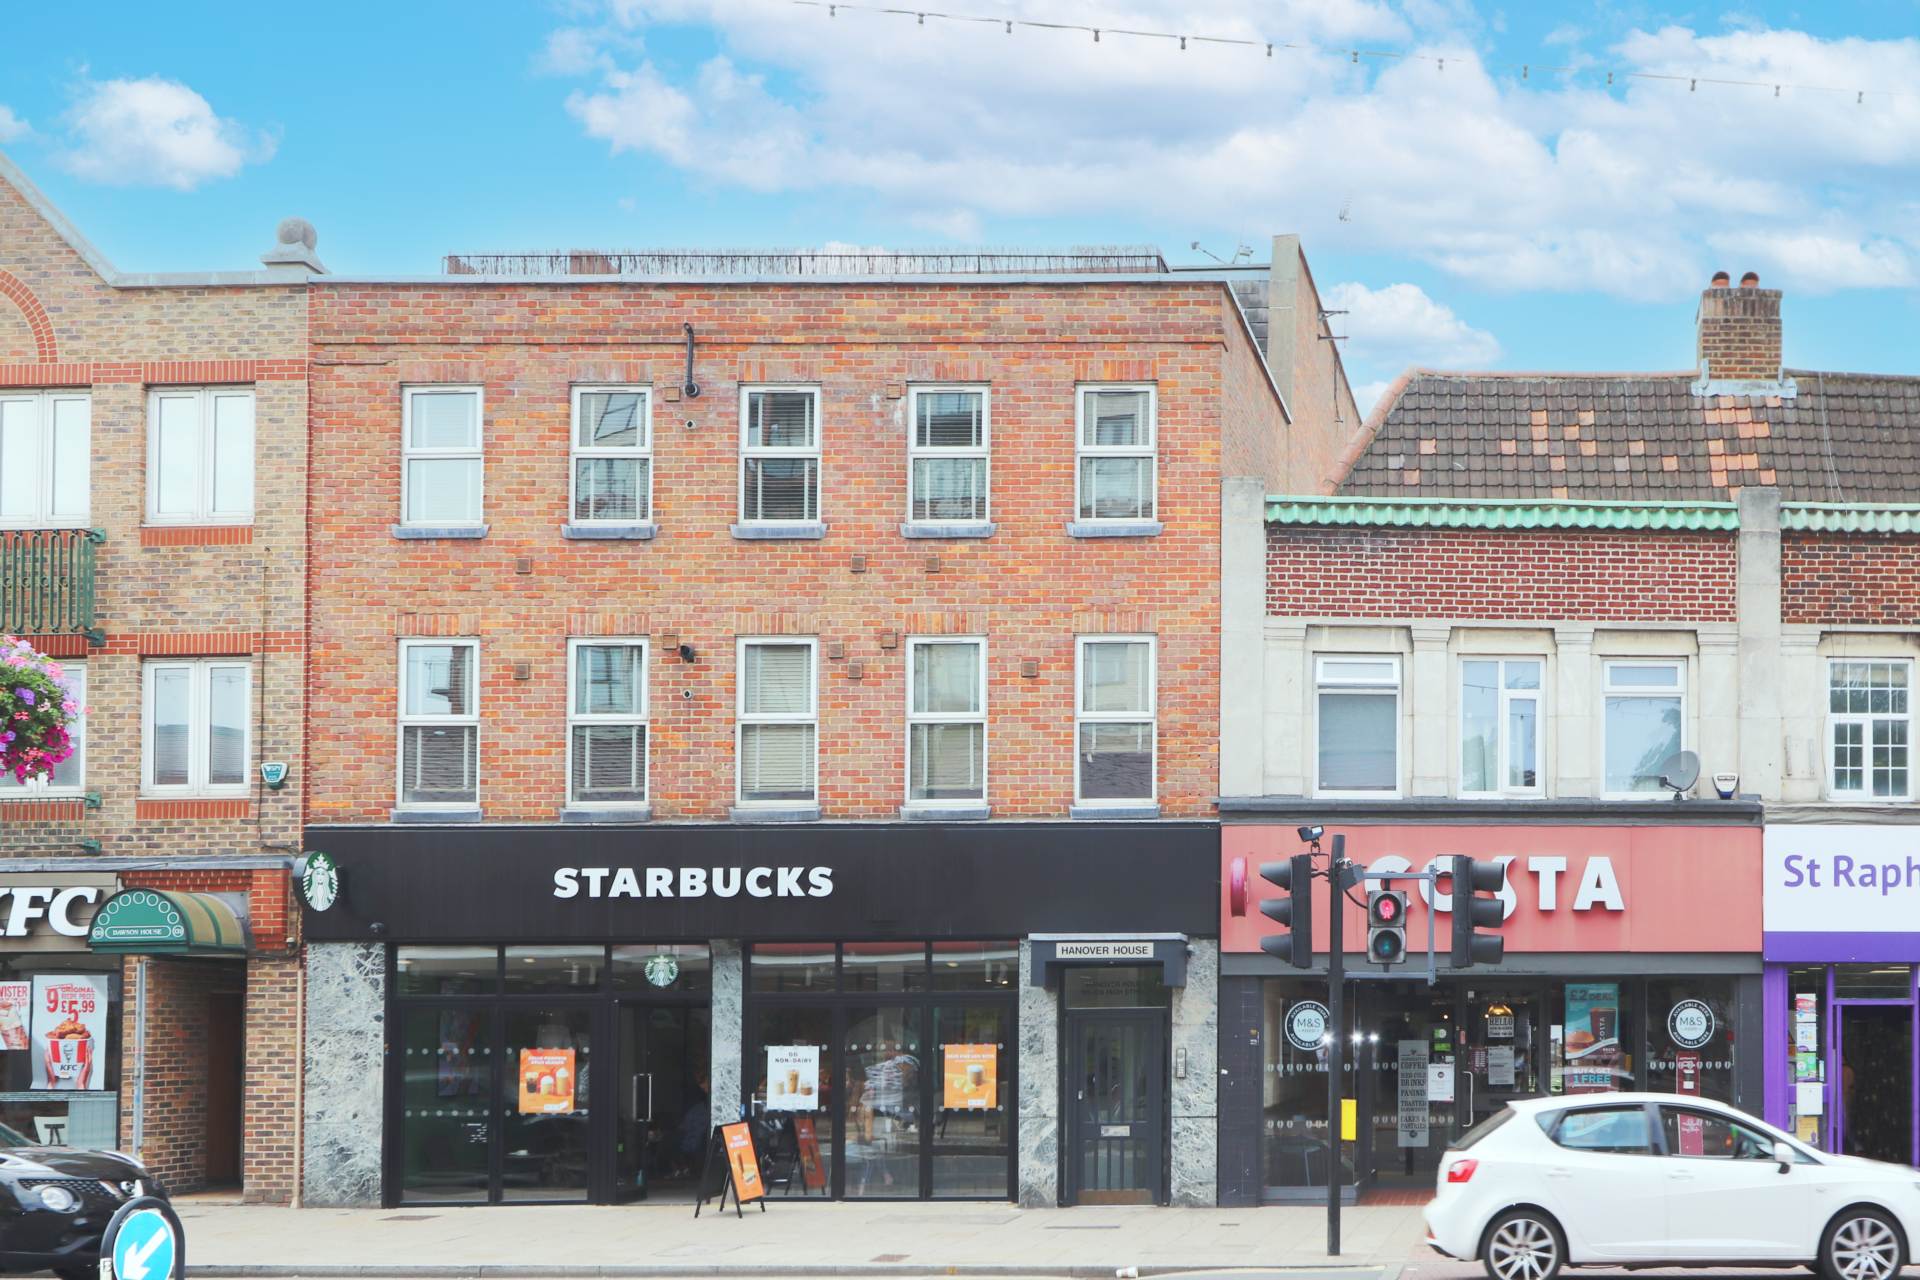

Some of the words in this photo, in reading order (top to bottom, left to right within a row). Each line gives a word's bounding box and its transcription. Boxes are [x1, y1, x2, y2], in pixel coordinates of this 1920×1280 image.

[552, 865, 834, 899] STARBUCKS
[1783, 854, 1821, 888] St
[1833, 855, 1920, 896] Raph
[0, 886, 98, 937] FC
[1061, 946, 1109, 955] HANOVER
[1113, 946, 1149, 955] HOUSE
[46, 988, 59, 1013] 9
[1297, 1018, 1321, 1028] M&S
[1680, 1016, 1703, 1026] M&S
[1581, 1074, 1611, 1085] FREE
